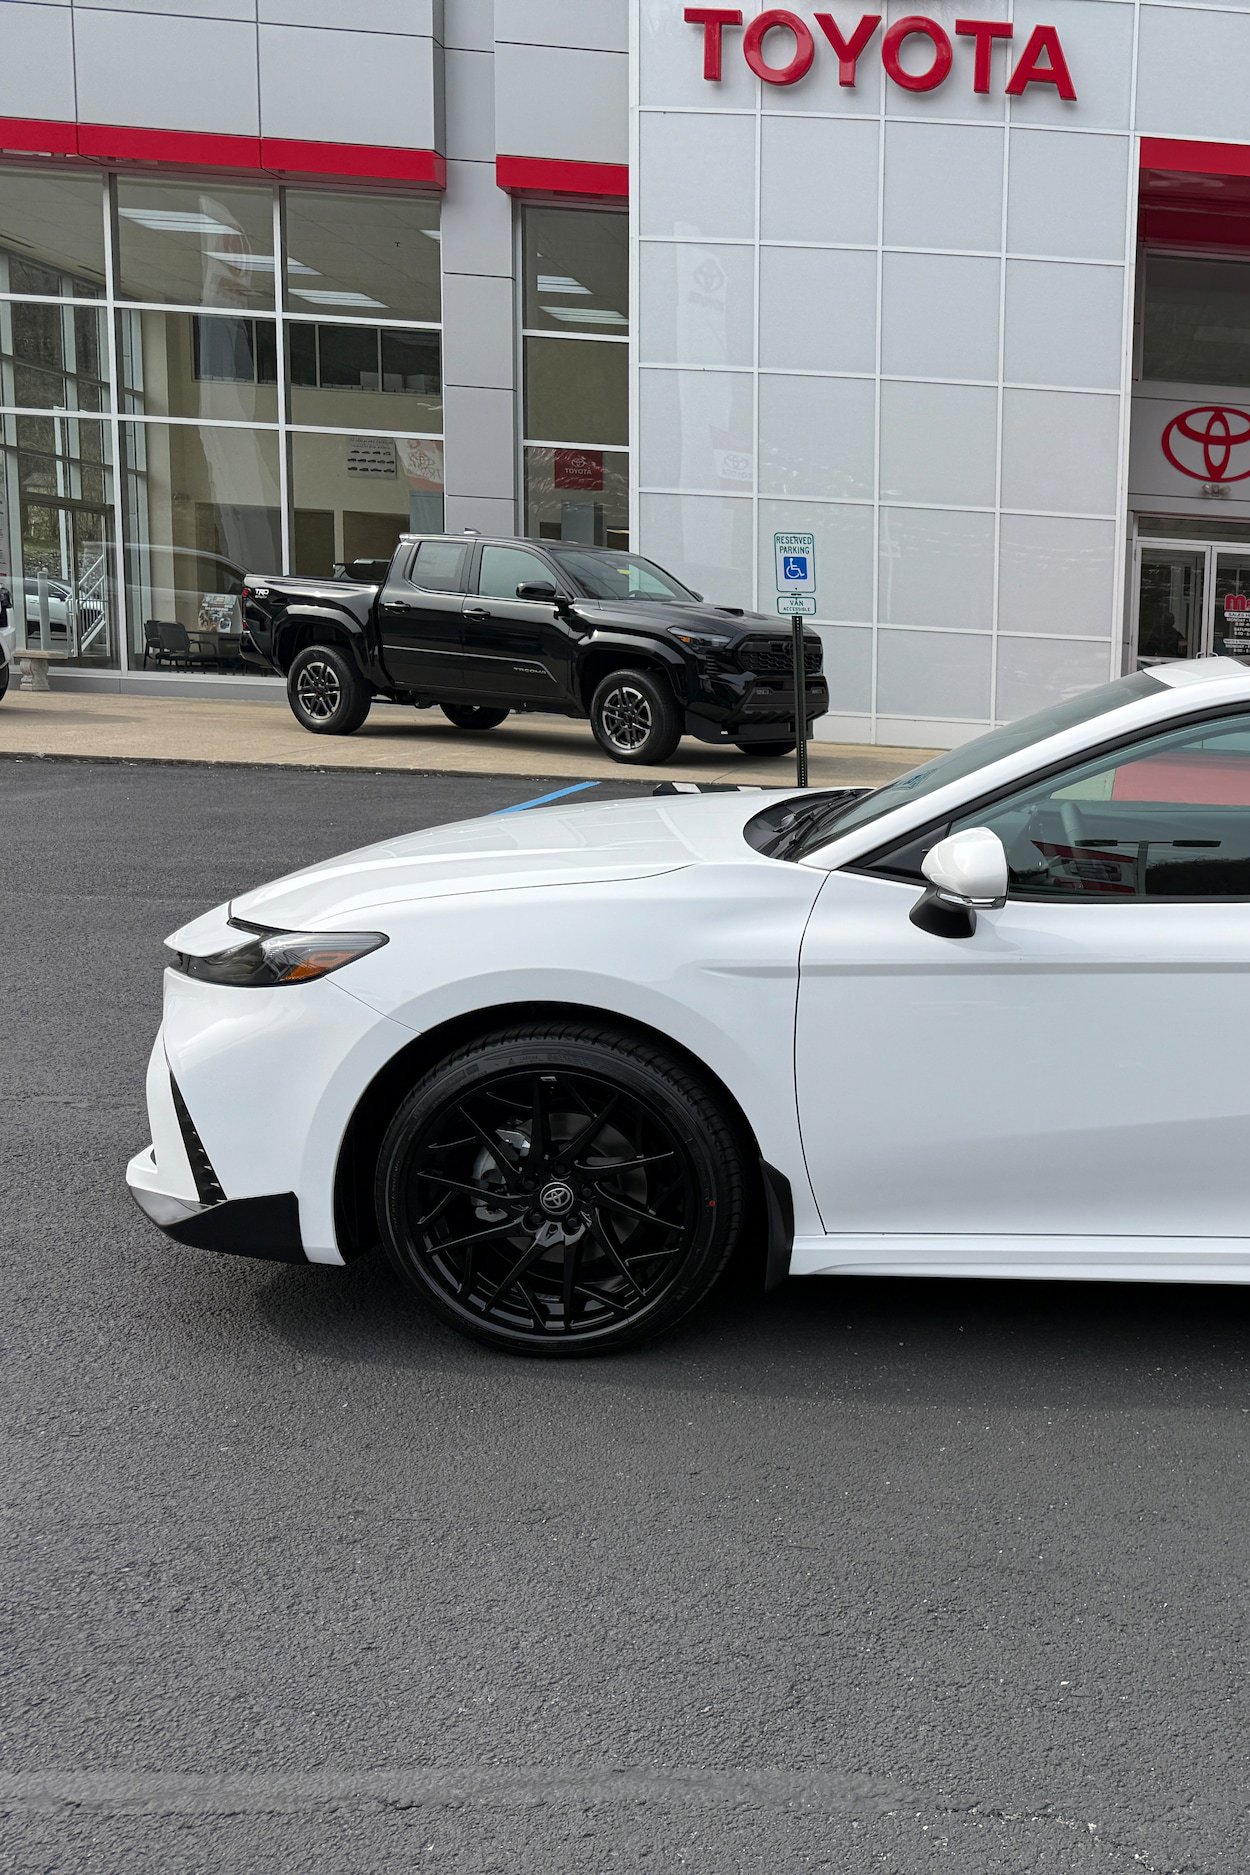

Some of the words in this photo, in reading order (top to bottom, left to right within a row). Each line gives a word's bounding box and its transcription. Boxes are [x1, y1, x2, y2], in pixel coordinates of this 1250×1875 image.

[684, 8, 1077, 101] TOYOTA
[565, 467, 592, 475] TOYOTA
[776, 535, 812, 545] RESERVED
[779, 545, 810, 555] PARKING
